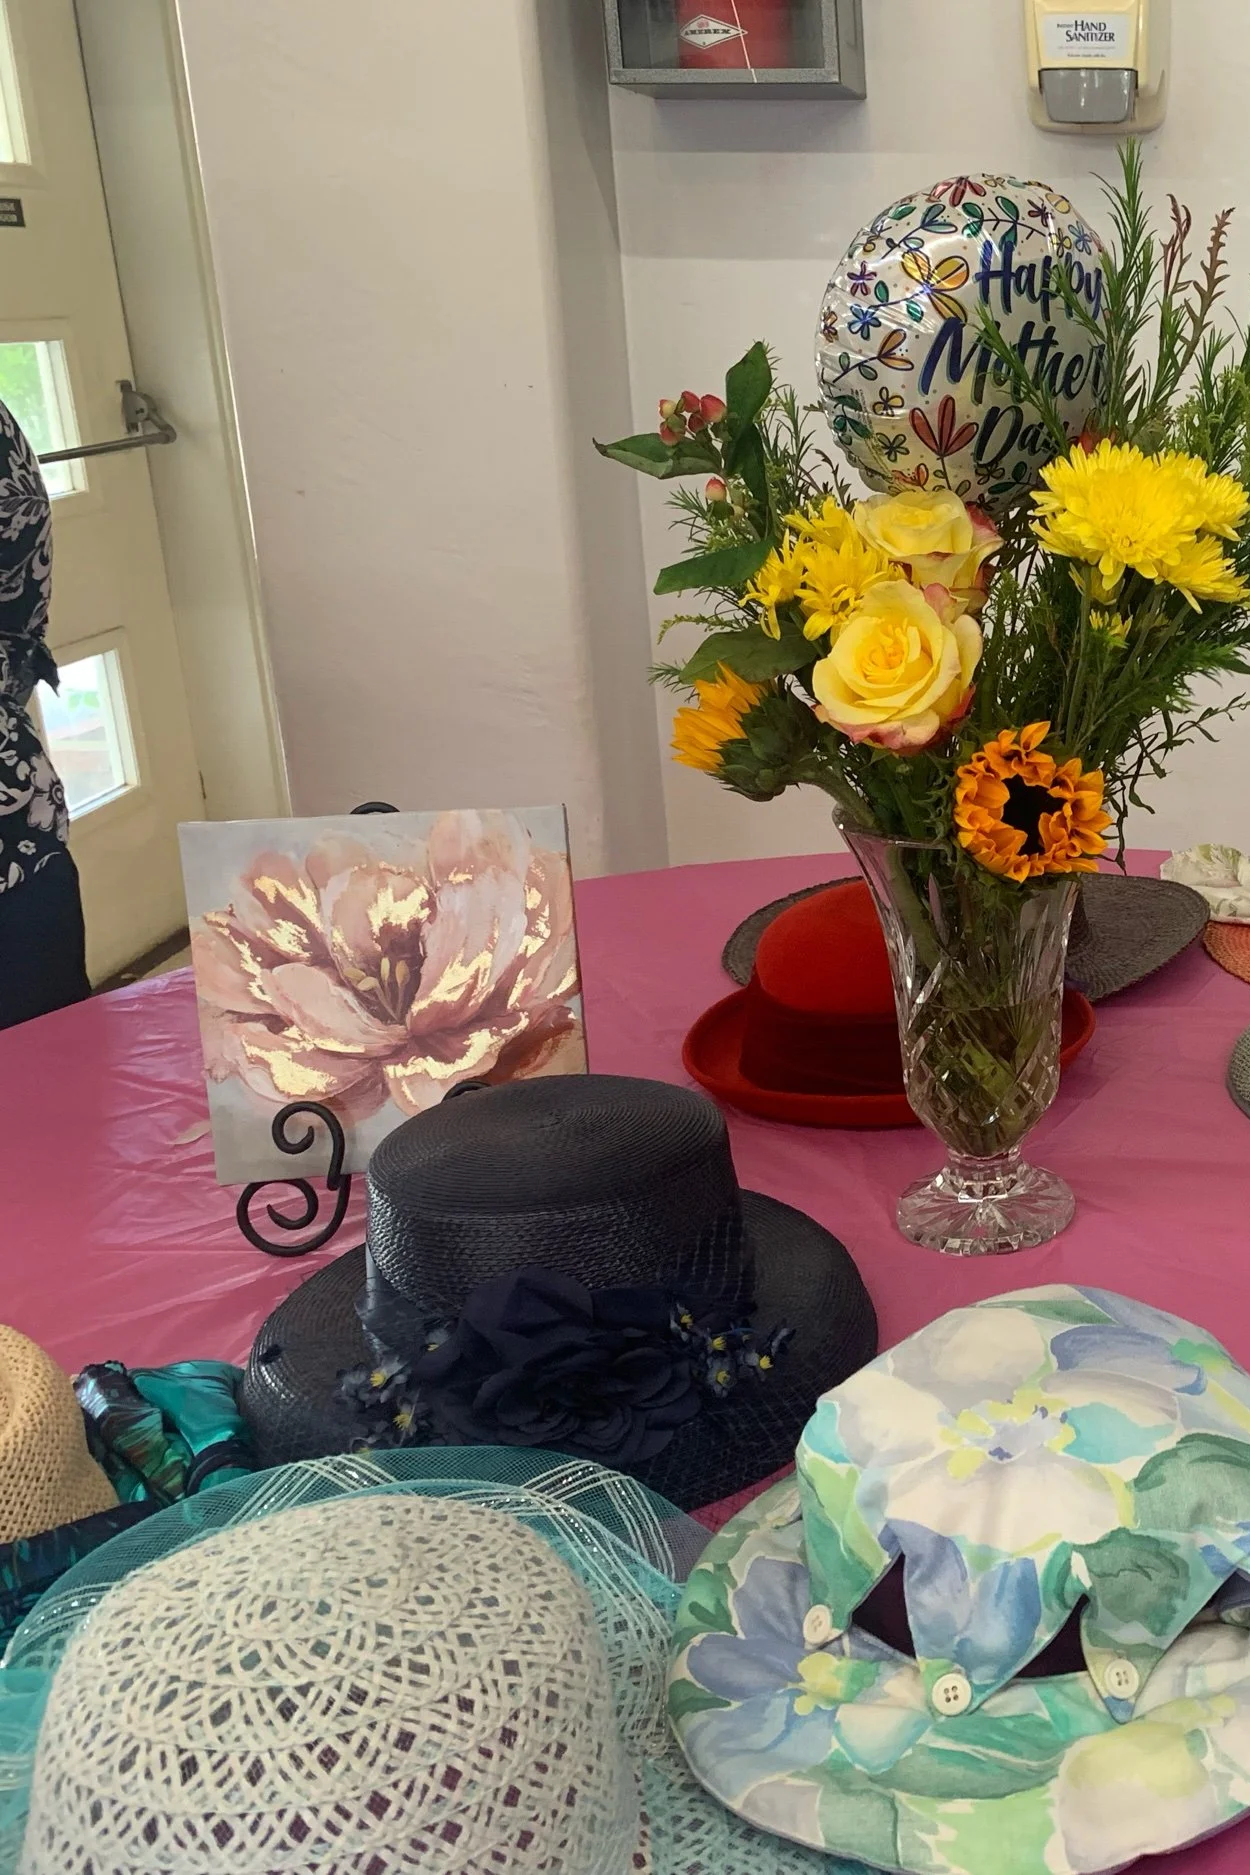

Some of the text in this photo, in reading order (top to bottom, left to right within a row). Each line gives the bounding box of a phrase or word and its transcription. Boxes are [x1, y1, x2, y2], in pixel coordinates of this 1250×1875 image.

[1074, 20, 1107, 31] HAND
[1065, 30, 1115, 42] SANITIZER
[972, 239, 1102, 324] Happy
